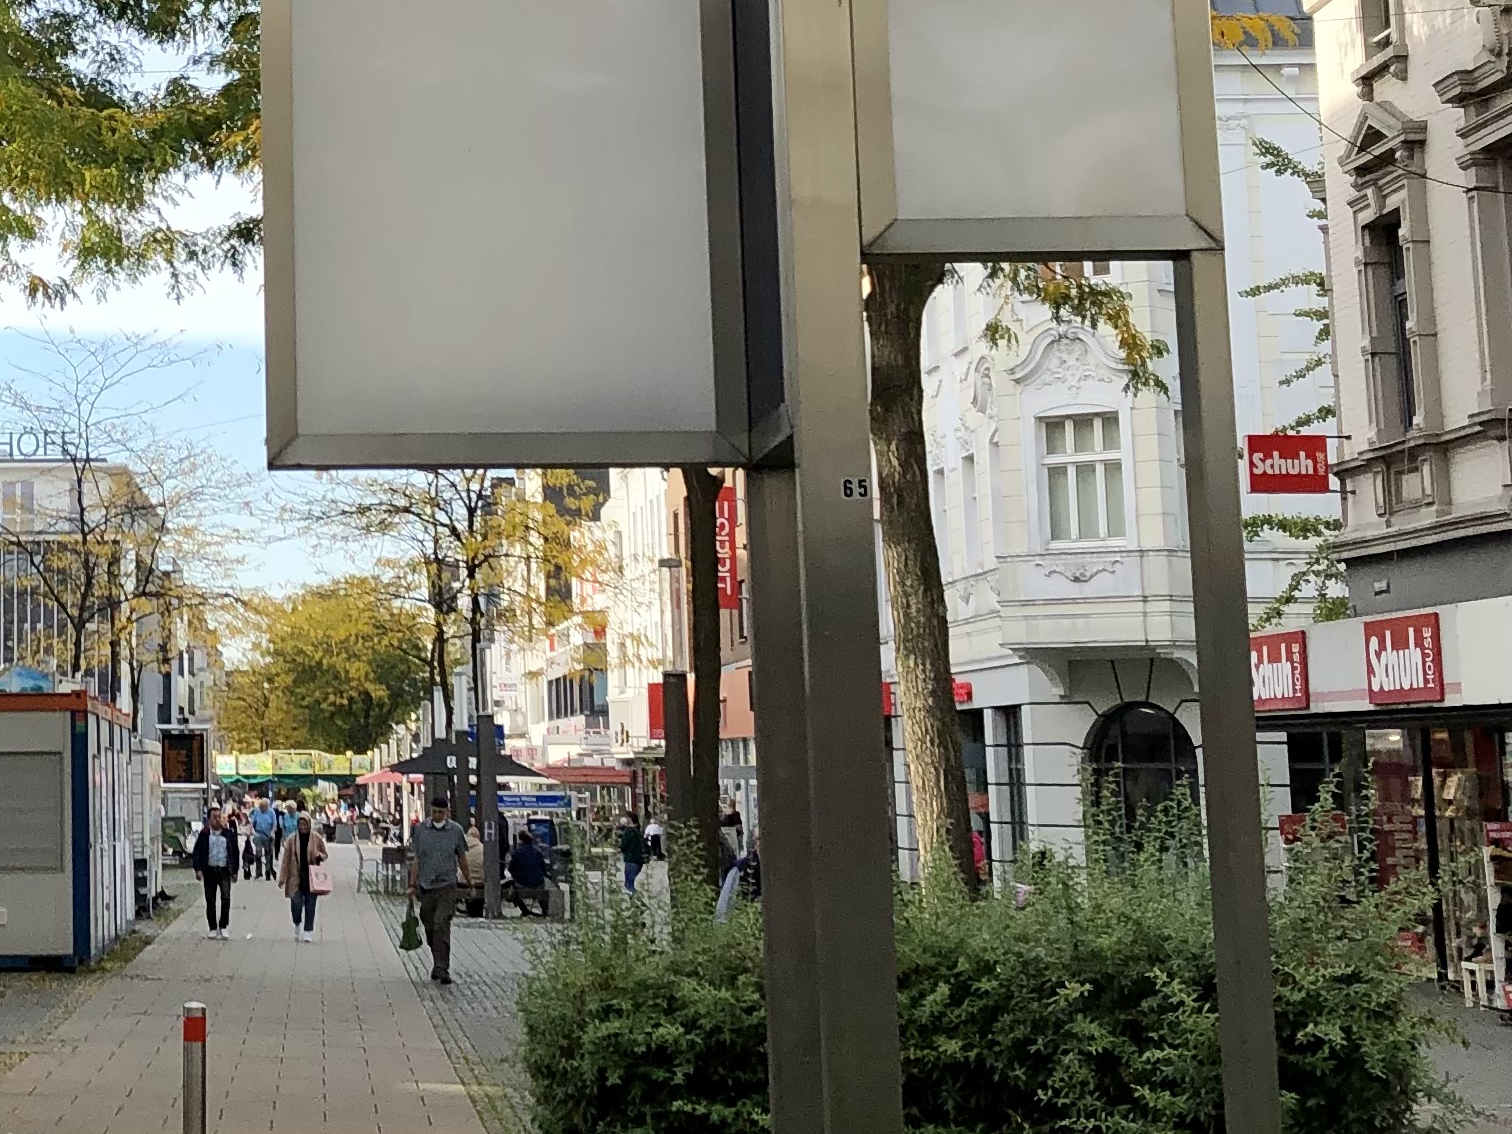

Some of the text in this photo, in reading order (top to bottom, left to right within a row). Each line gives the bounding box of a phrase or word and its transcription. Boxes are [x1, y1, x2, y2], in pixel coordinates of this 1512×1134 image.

[843, 478, 868, 498] 65
[1252, 451, 1314, 476] Schuh
[1316, 451, 1326, 476] HOUSE
[1252, 641, 1293, 700] Schuh
[1292, 642, 1302, 697] HOUSE
[1368, 626, 1425, 693] Schuh
[1423, 626, 1436, 688] HOUSE
